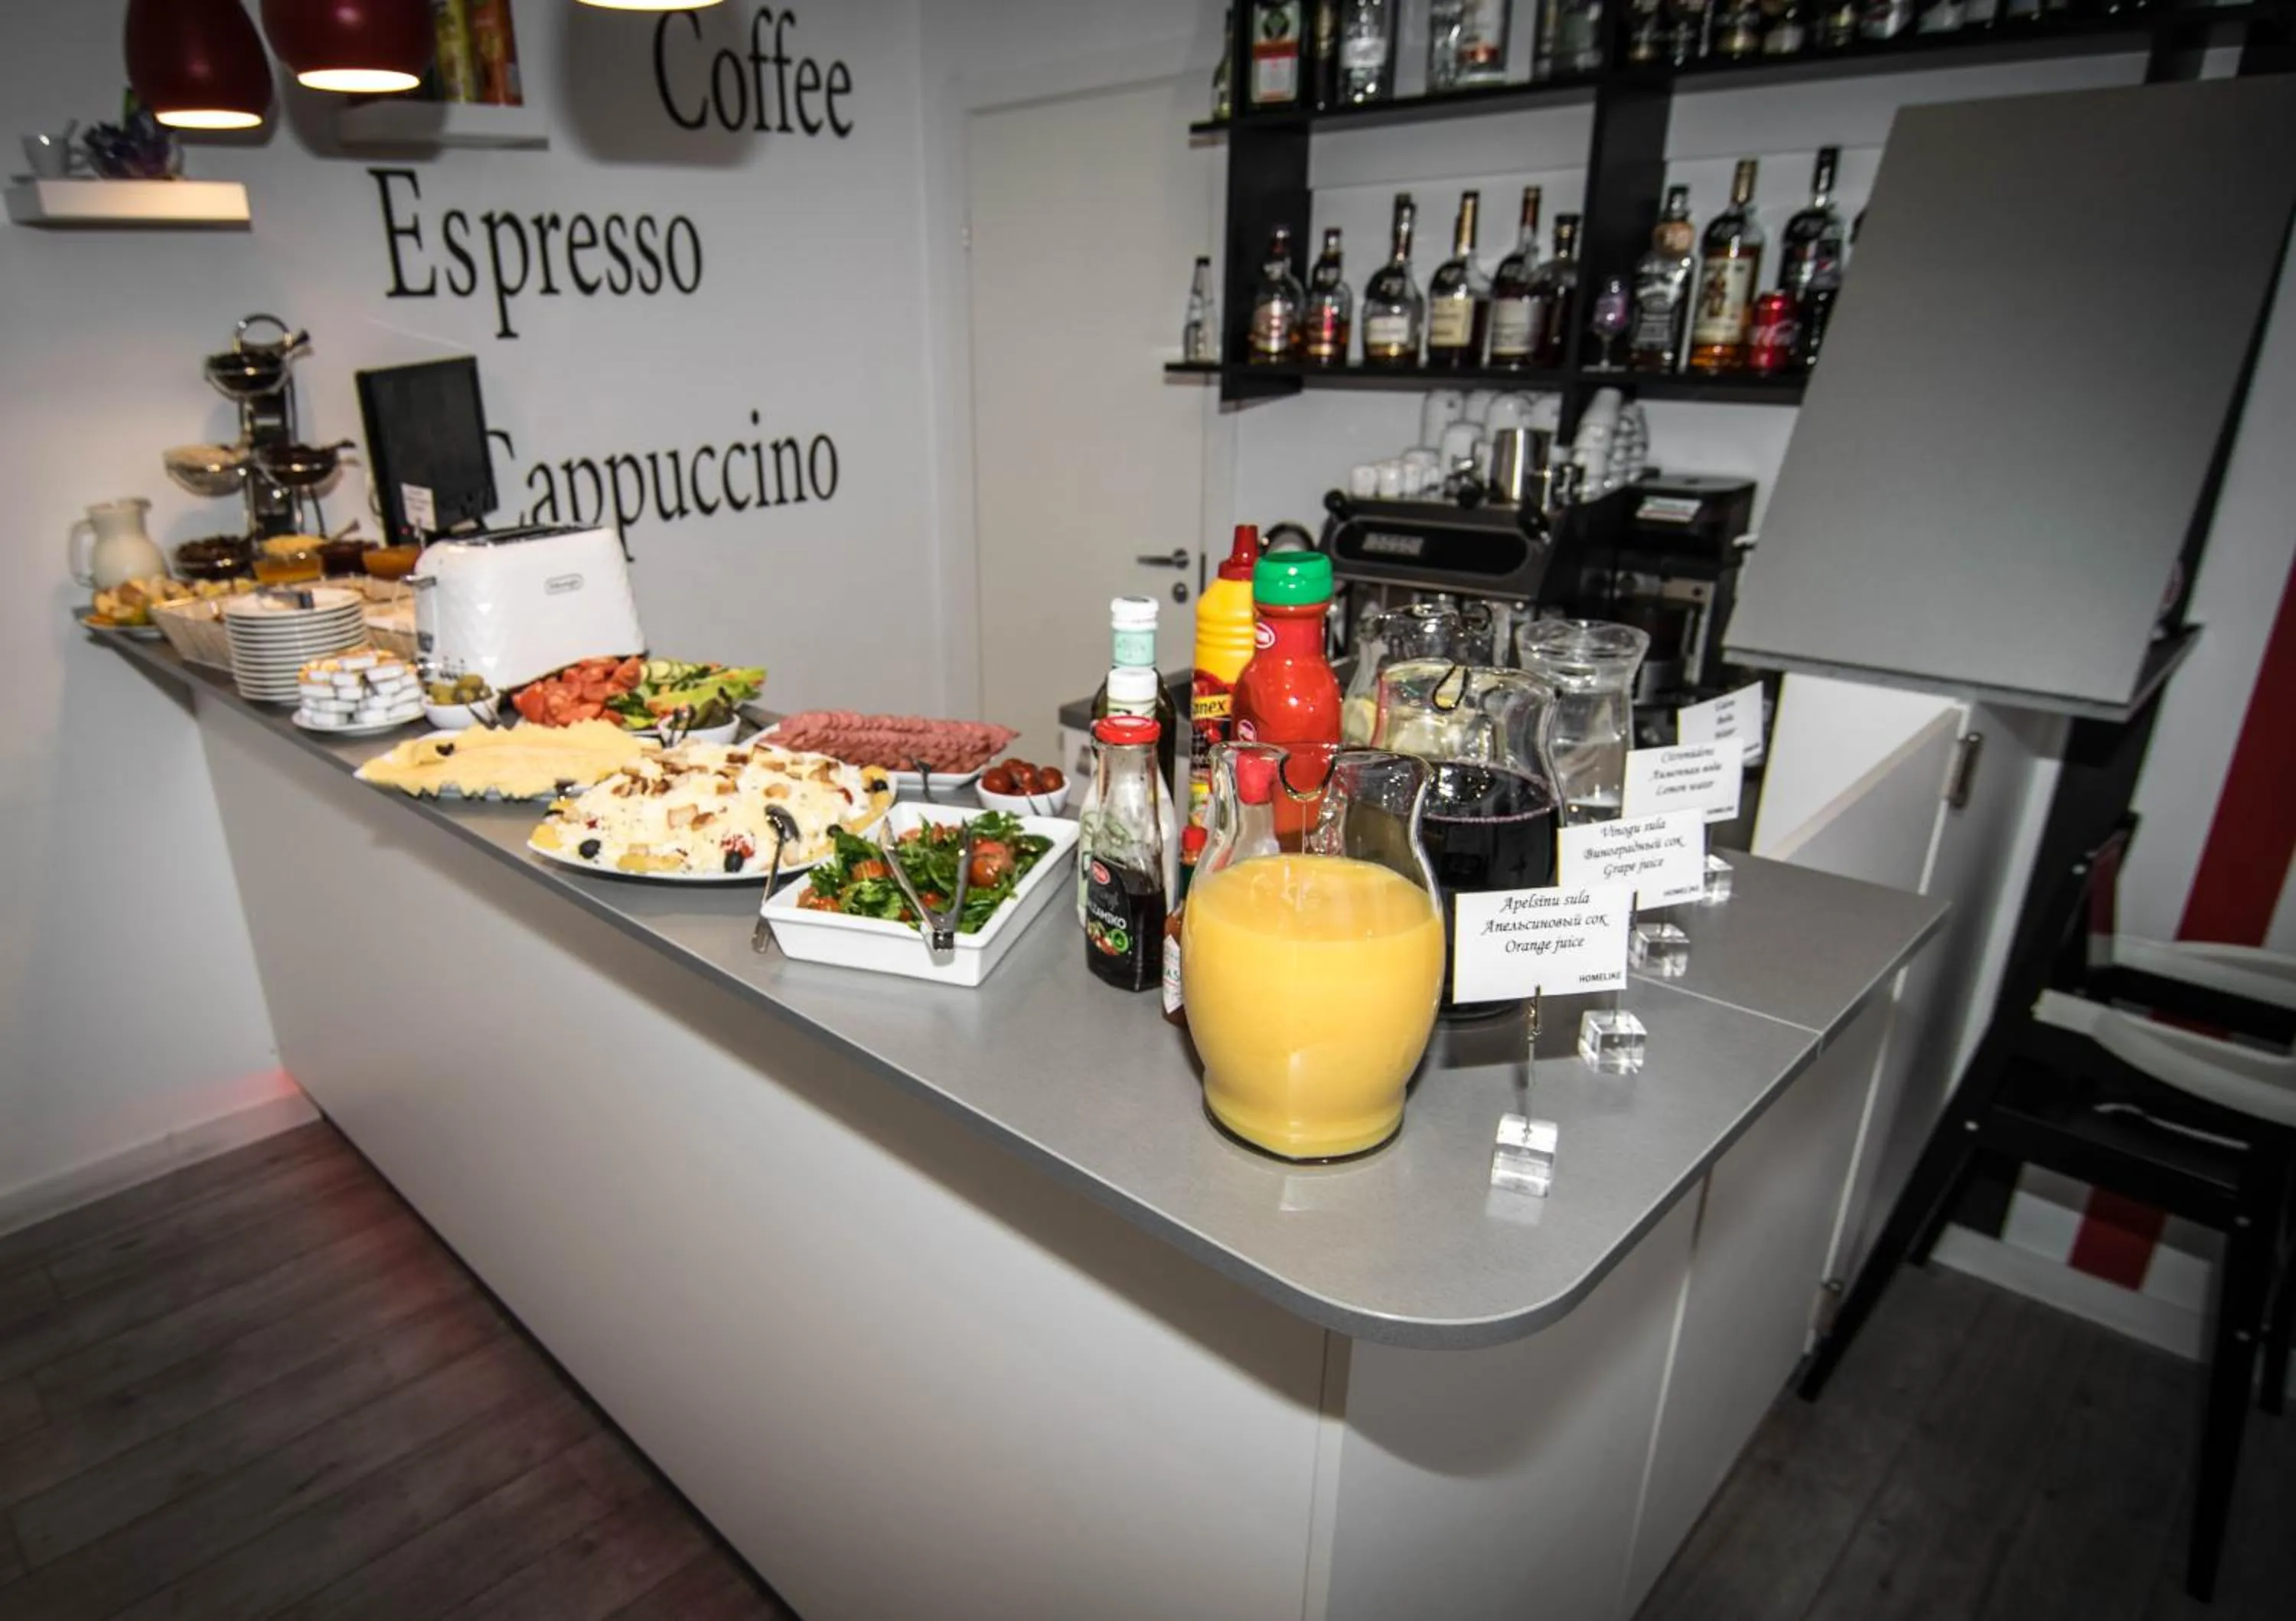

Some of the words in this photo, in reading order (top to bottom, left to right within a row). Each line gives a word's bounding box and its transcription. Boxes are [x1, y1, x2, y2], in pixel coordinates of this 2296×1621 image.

[653, 7, 853, 139] Coffee
[367, 168, 703, 339] Espresso
[485, 409, 840, 562] appuccino
[1644, 817, 1666, 831] sula
[1603, 862, 1636, 879] Grape
[1637, 858, 1665, 874] juice
[1563, 889, 1590, 905] sula
[1481, 914, 1581, 935] Апельсиновый
[1585, 914, 1610, 927] сок
[1505, 939, 1551, 955] Orange
[1552, 934, 1586, 954] juice
[1579, 971, 1622, 983] HOMELIKE
